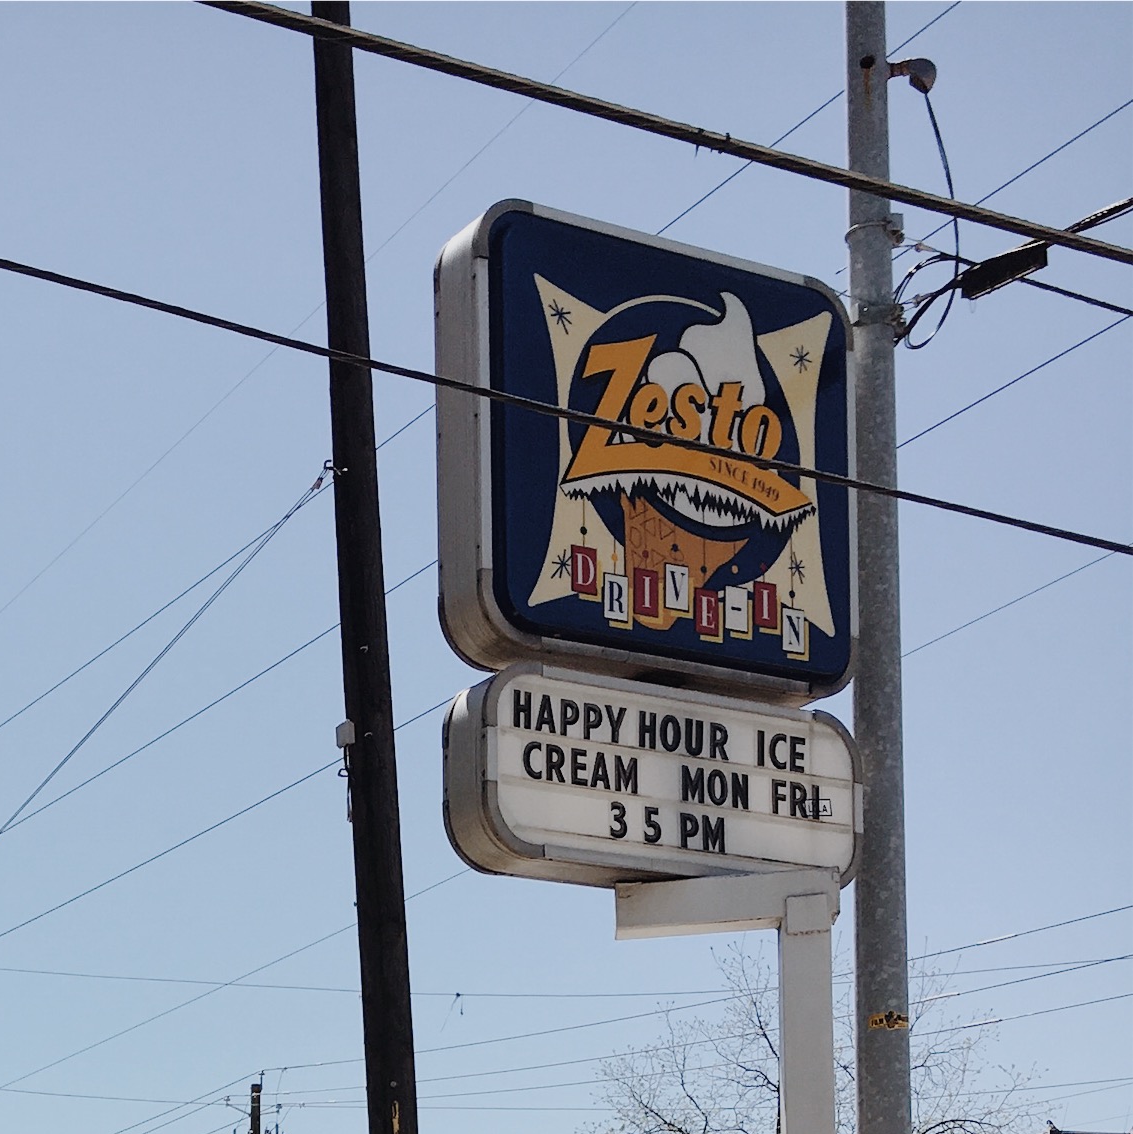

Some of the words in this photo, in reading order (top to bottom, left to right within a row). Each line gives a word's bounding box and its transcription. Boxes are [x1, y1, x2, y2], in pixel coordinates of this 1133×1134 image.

[565, 332, 783, 481] Zesto
[710, 456, 749, 485] SINCE
[752, 477, 780, 501] 1949
[575, 552, 800, 647] DRIVE-IN
[513, 689, 627, 744] HAPPY
[638, 711, 729, 761] HOUR
[757, 730, 806, 773] ICE
[522, 741, 639, 794] CREAM
[681, 765, 749, 810] MON
[771, 779, 820, 820] FRI
[609, 801, 628, 839] 3
[643, 807, 662, 843] 5
[679, 812, 726, 854] PM
